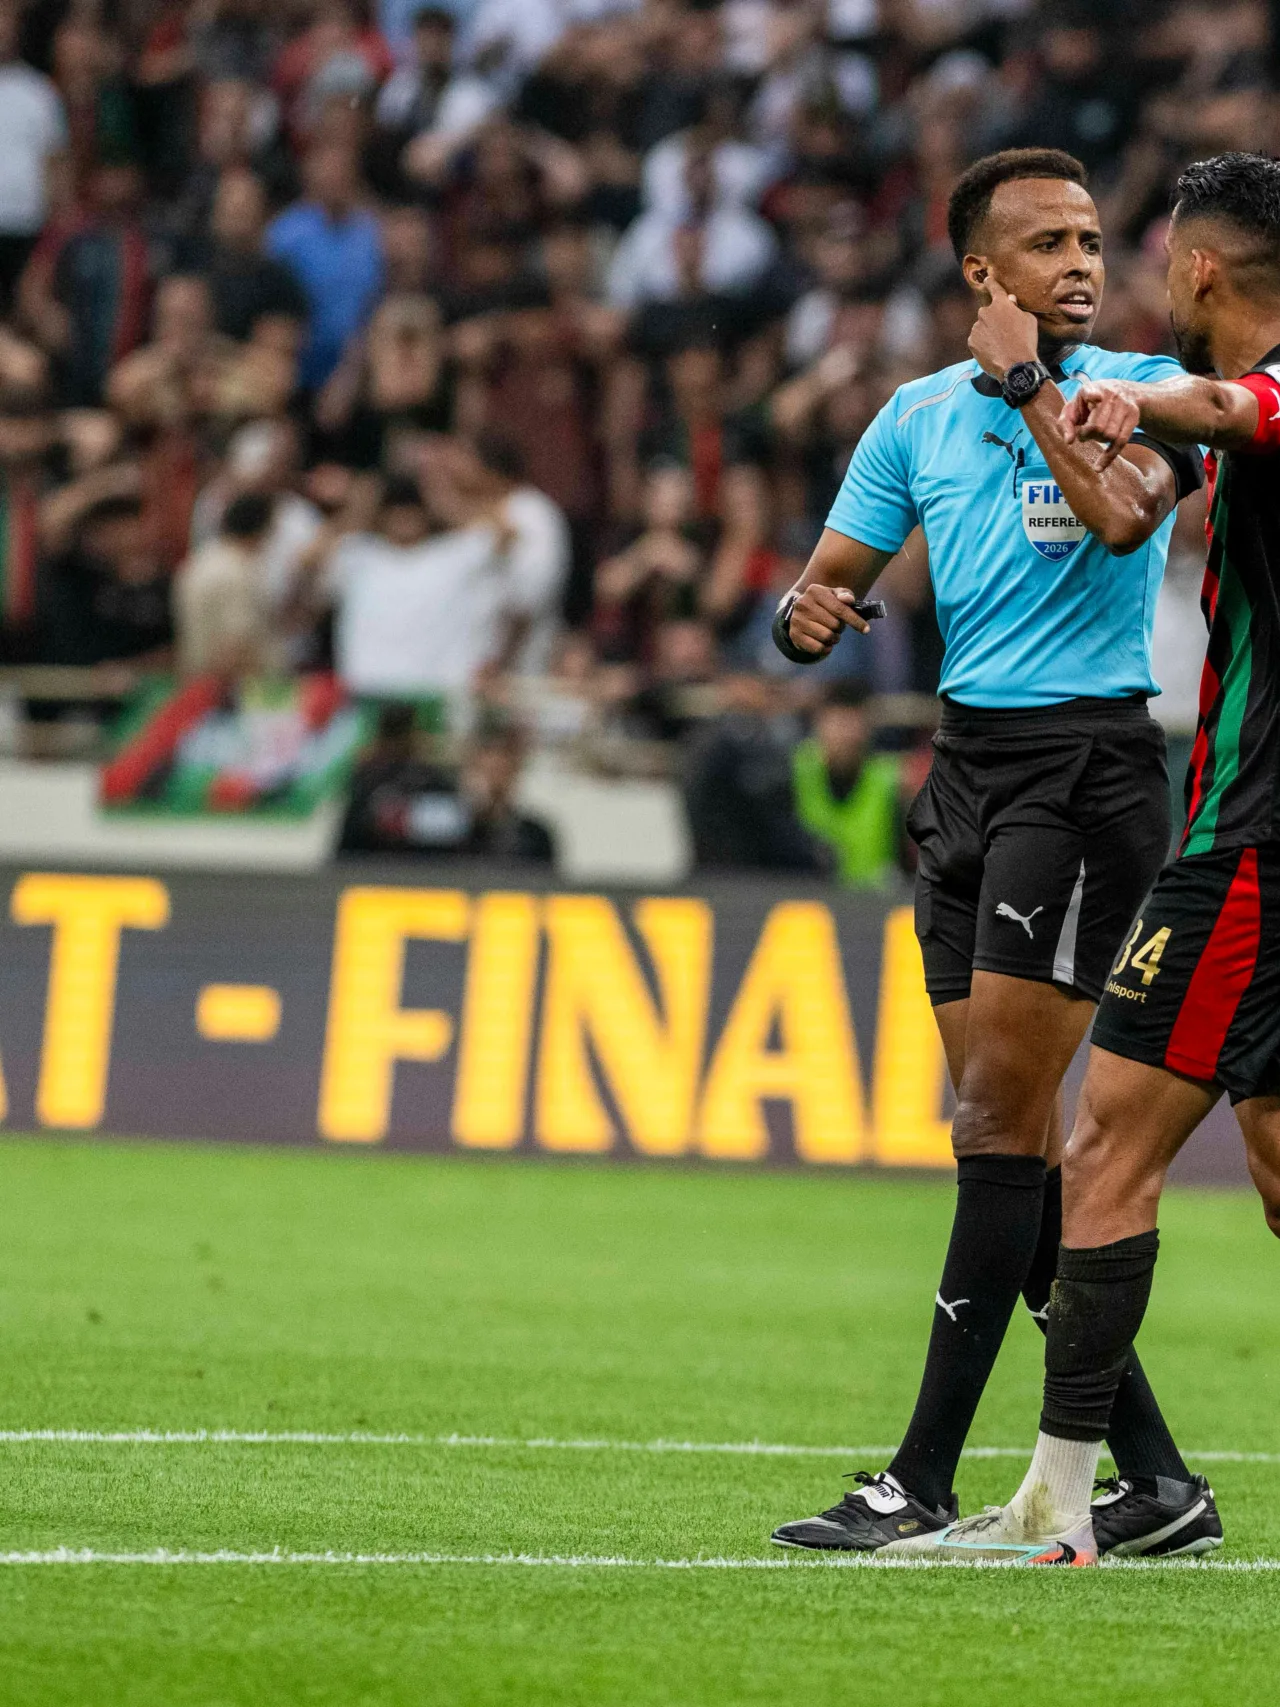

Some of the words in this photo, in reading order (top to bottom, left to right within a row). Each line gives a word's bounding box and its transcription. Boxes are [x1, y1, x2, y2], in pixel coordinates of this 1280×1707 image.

[1028, 485, 1068, 505] FIF
[1043, 543, 1069, 554] 2026
[0, 871, 171, 1130] T
[316, 885, 957, 1168] FINAL
